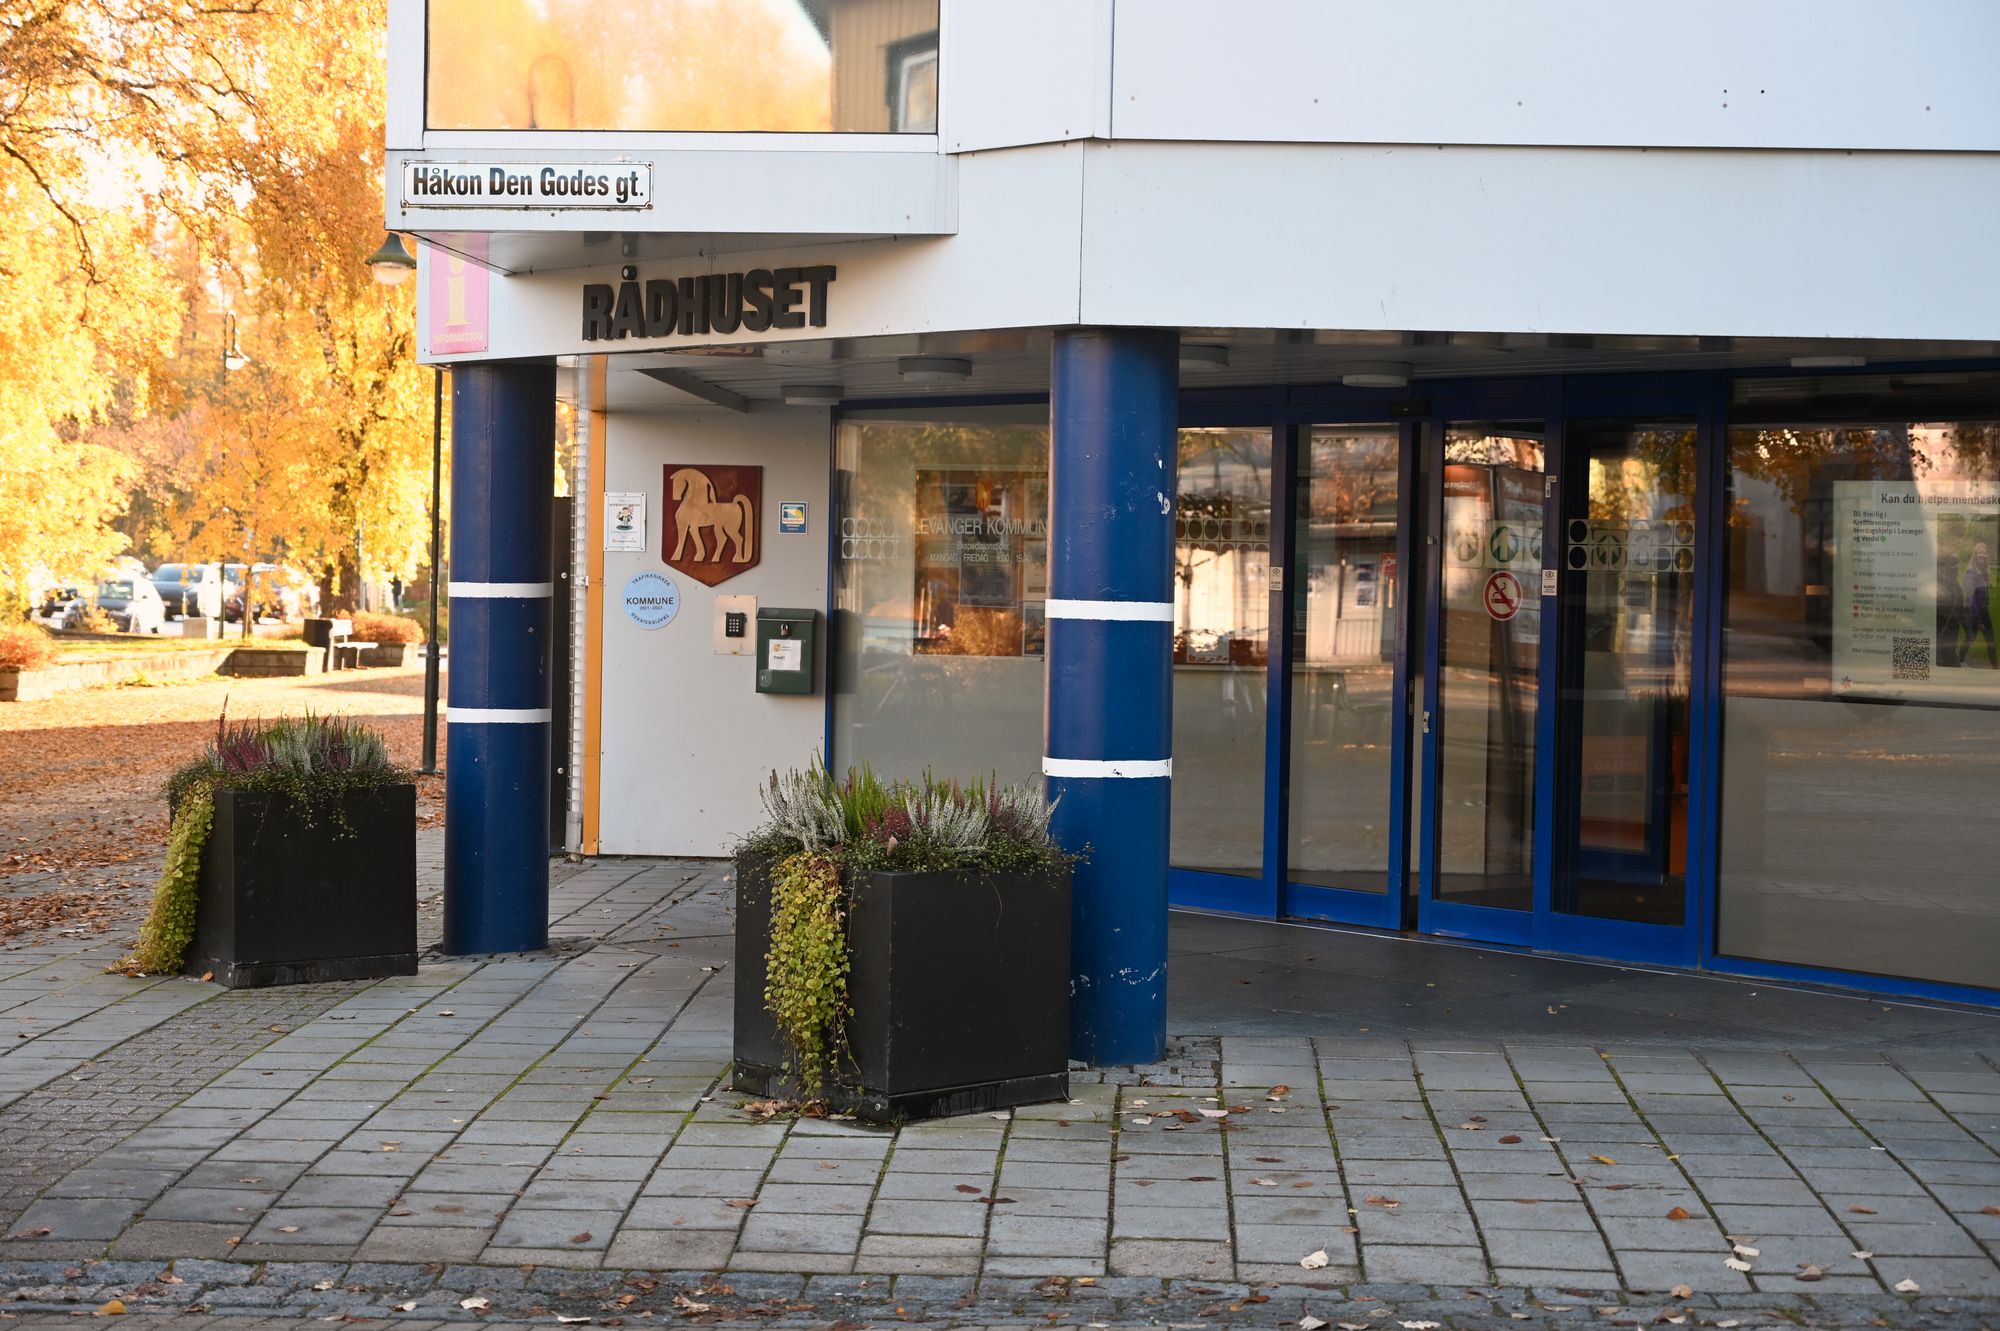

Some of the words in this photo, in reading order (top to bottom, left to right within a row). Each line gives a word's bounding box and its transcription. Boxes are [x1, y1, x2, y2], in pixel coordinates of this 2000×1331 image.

[413, 167, 482, 196] Håkon
[489, 167, 533, 196] Den
[540, 167, 609, 197] Godes
[616, 171, 644, 203] gt.
[582, 265, 837, 342] RÅDHUSET
[432, 330, 484, 345] INFORMATION
[1881, 493, 1900, 504] Kan
[1903, 493, 1915, 504] du
[1919, 494, 1949, 506] hjelpe
[914, 518, 982, 535] LEVANGER
[987, 518, 1047, 535] KOMMUN
[626, 597, 675, 605] KOMMUNE
